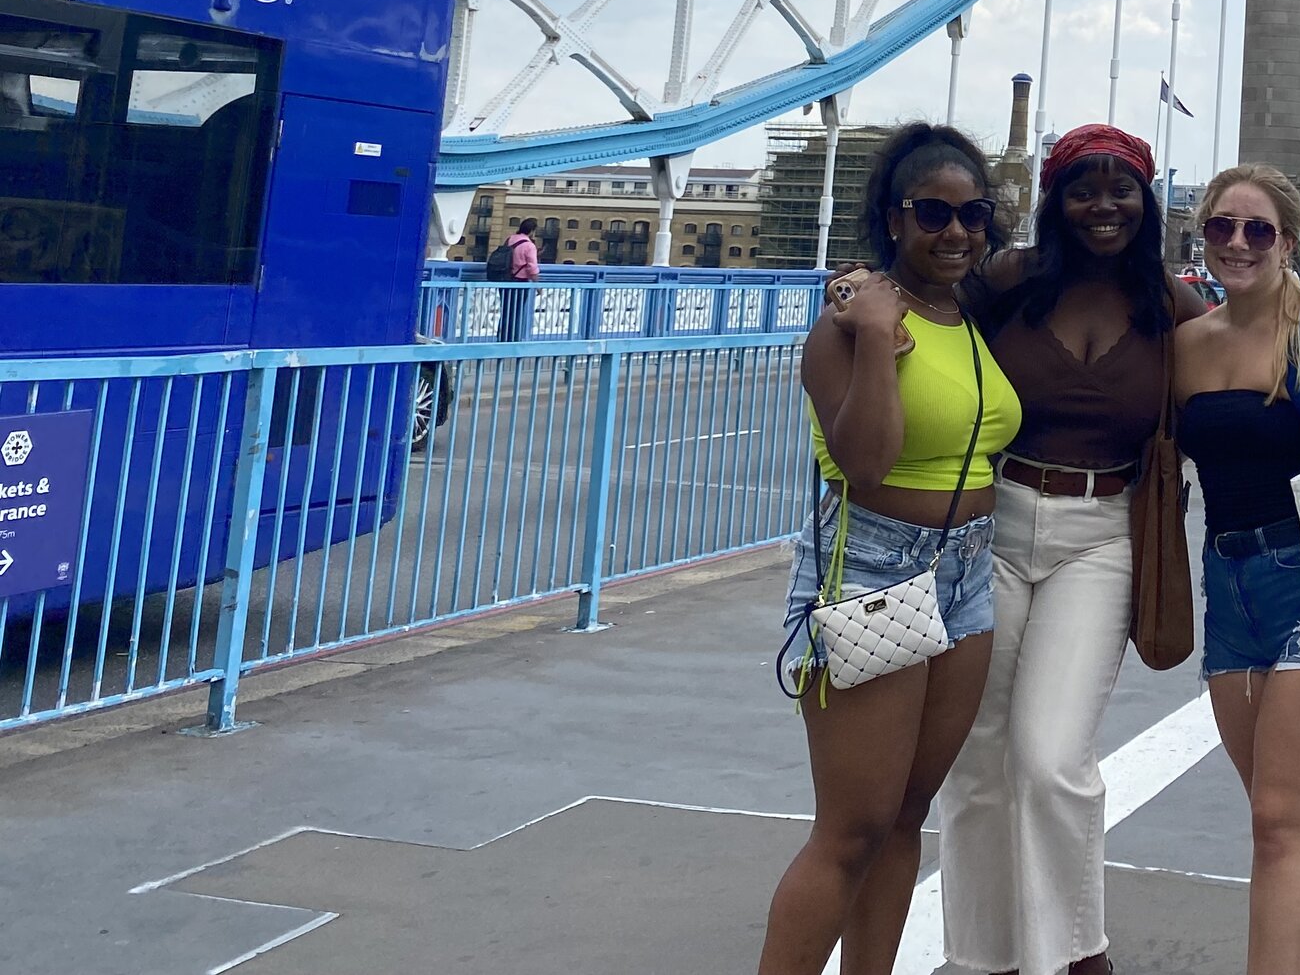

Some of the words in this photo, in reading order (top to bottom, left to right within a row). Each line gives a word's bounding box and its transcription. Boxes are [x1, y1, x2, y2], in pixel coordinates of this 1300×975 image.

[6, 434, 28, 445] TOWER
[4, 449, 28, 463] BRIDGE
[36, 477, 50, 494] &
